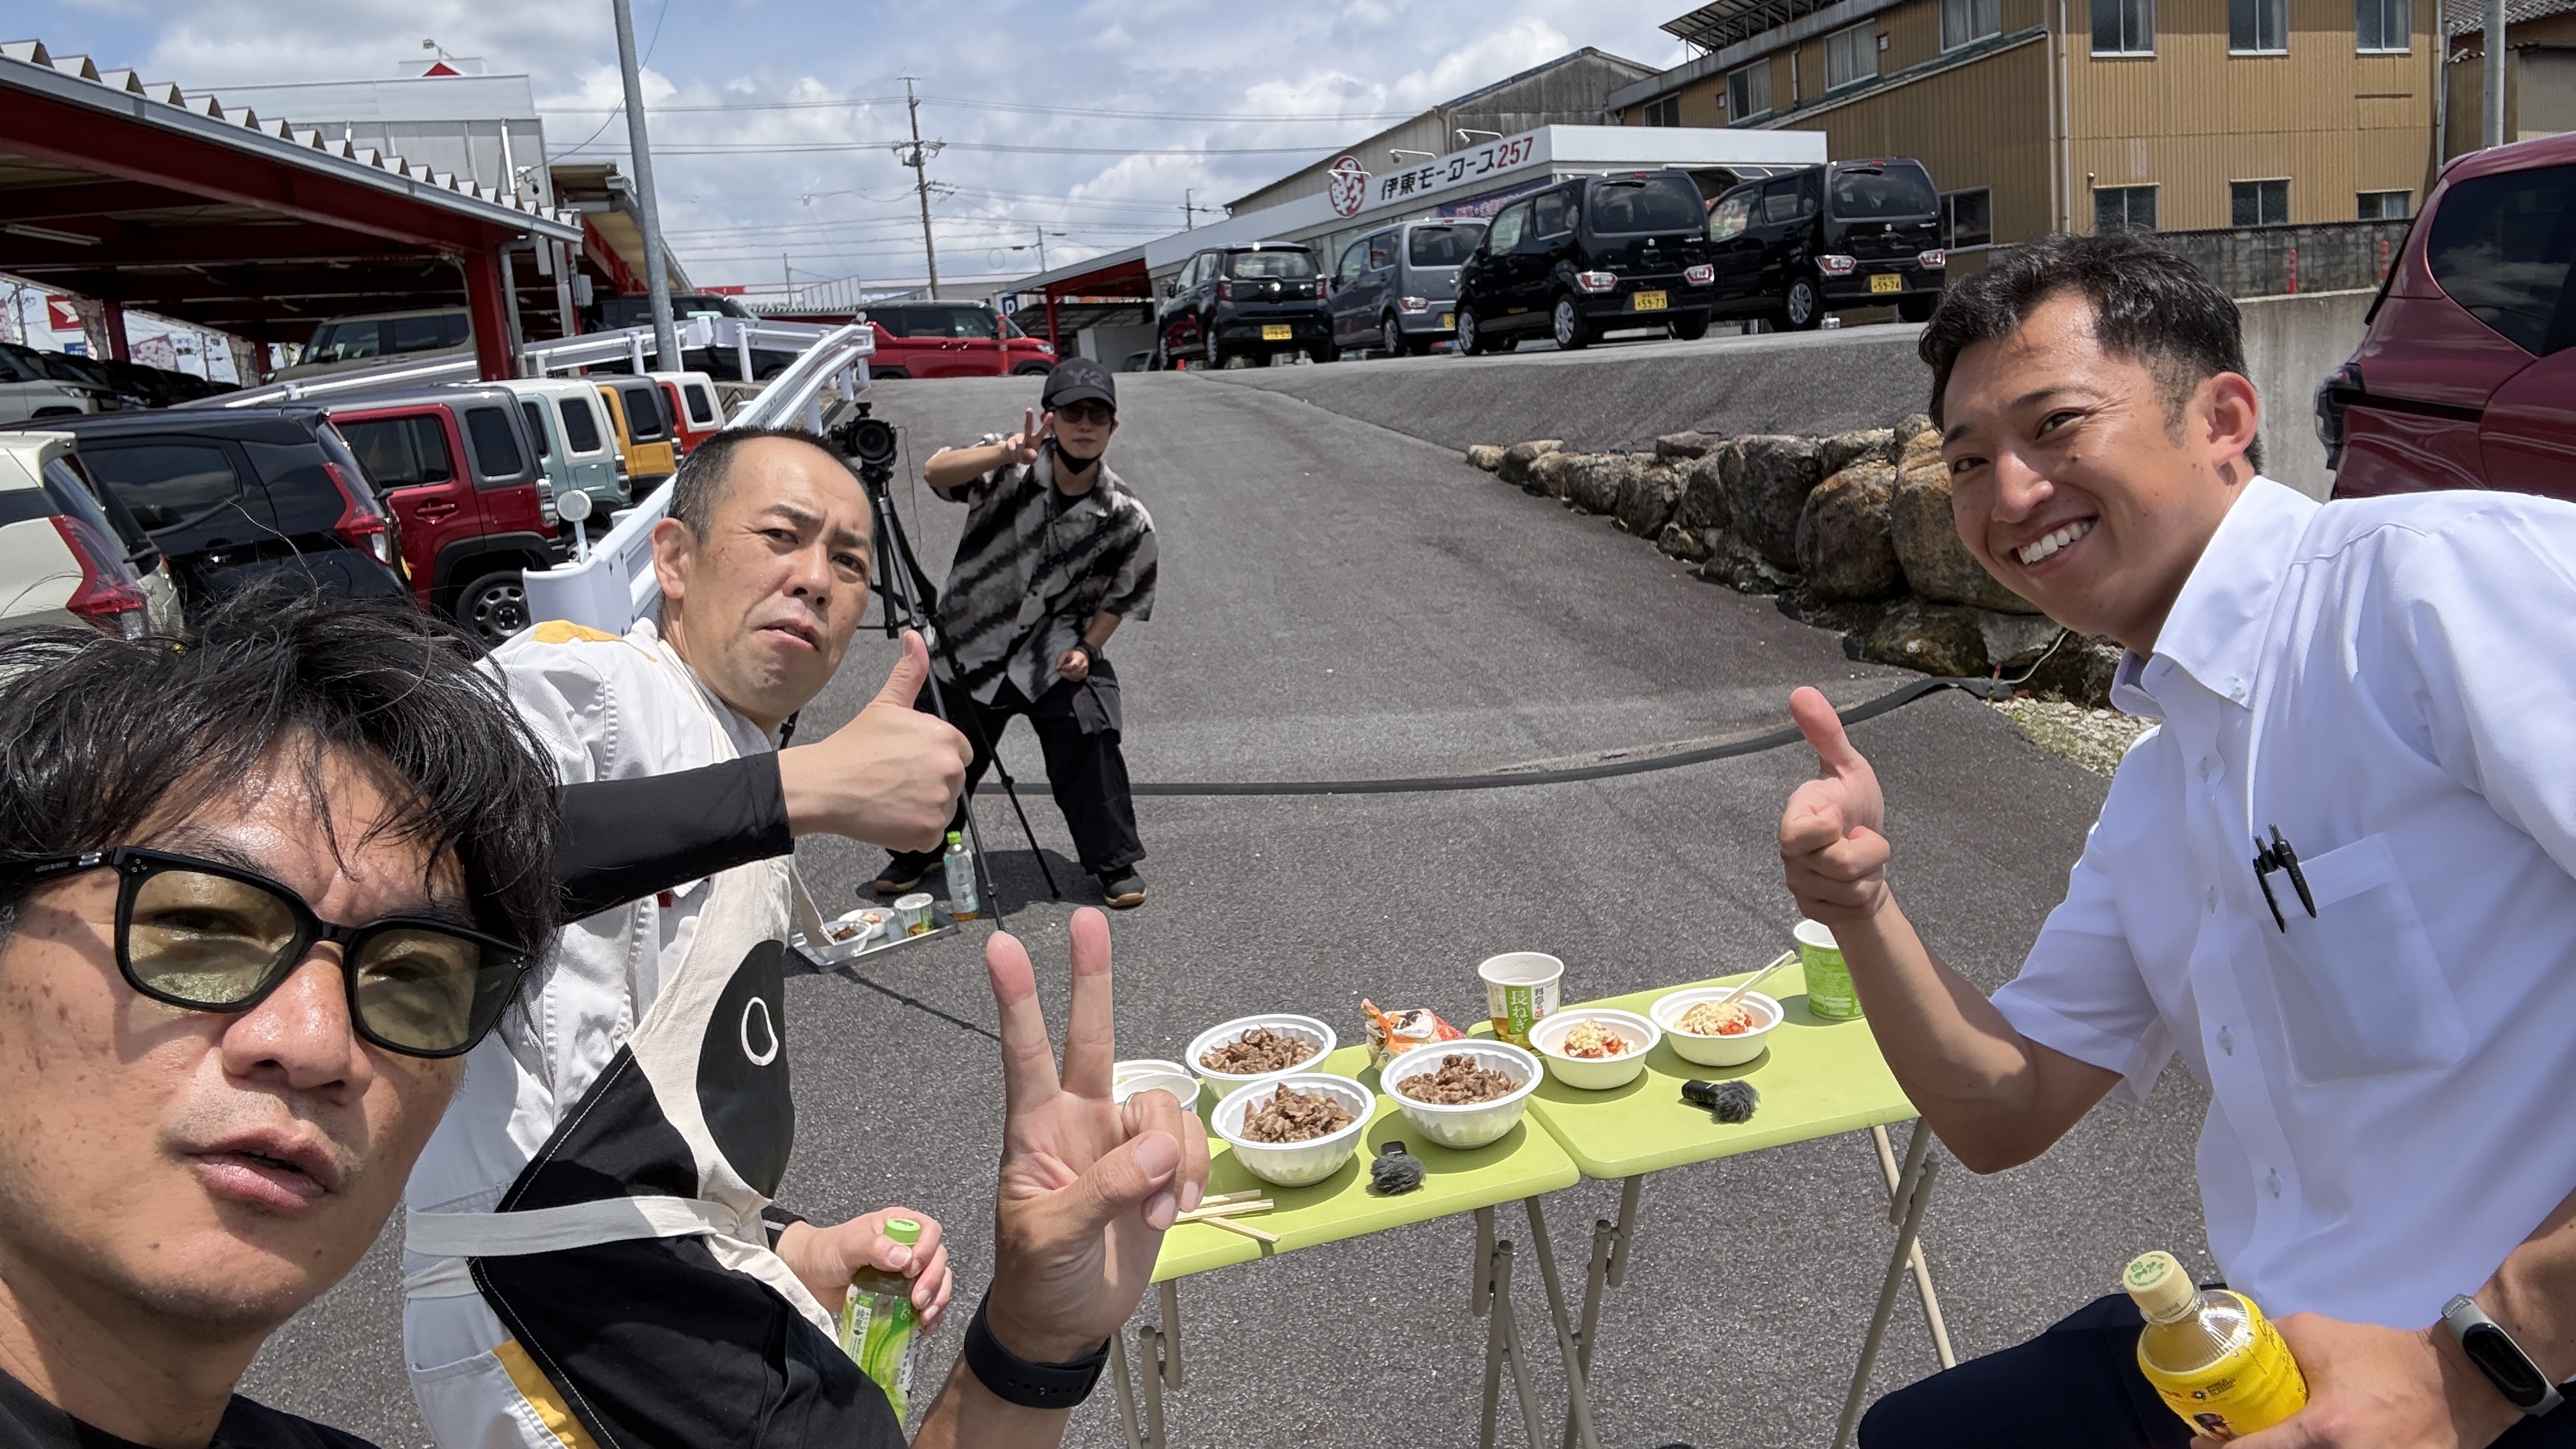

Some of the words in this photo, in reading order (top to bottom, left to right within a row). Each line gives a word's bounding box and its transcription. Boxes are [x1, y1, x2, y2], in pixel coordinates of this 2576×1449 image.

[1005, 300, 1016, 317] P
[1510, 990, 1528, 1032] 長ねぎ
